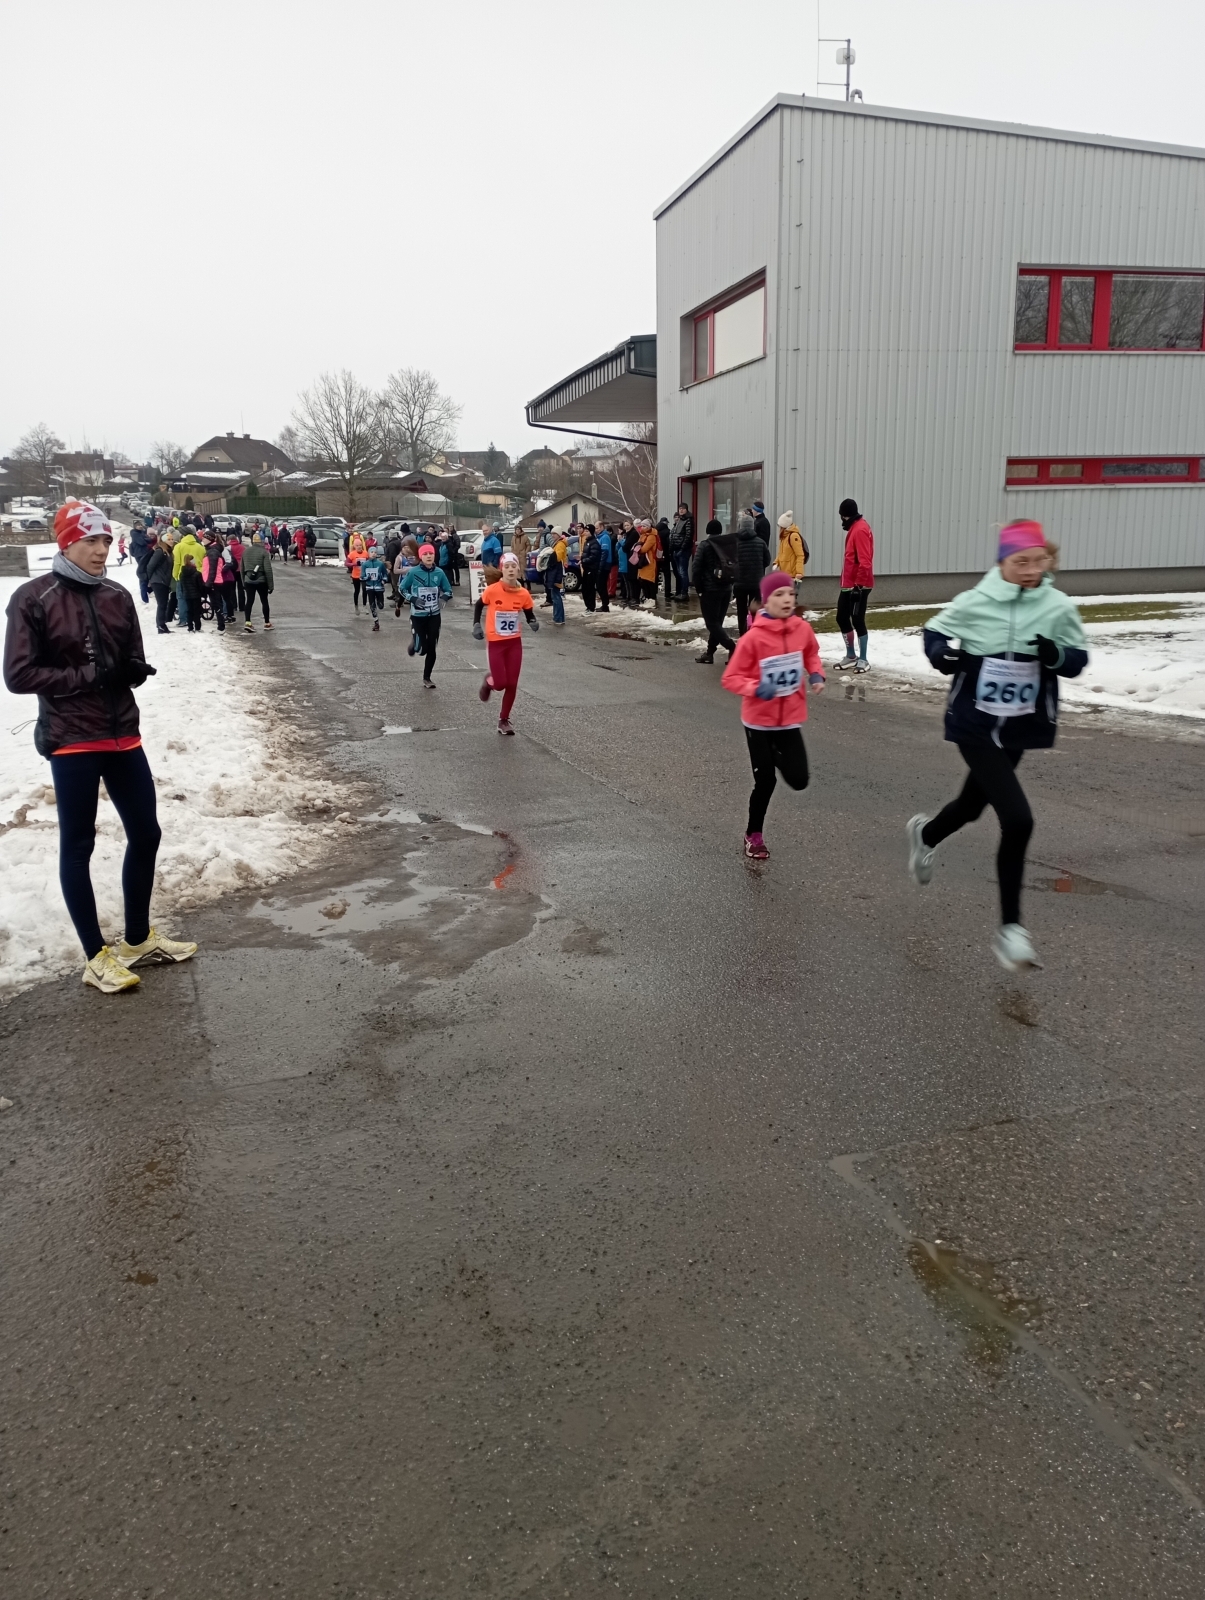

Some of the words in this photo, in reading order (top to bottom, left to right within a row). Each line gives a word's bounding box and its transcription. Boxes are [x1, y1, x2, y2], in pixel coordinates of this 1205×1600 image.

[420, 593, 437, 603] 263
[500, 620, 515, 631] 26
[766, 669, 799, 687] 142
